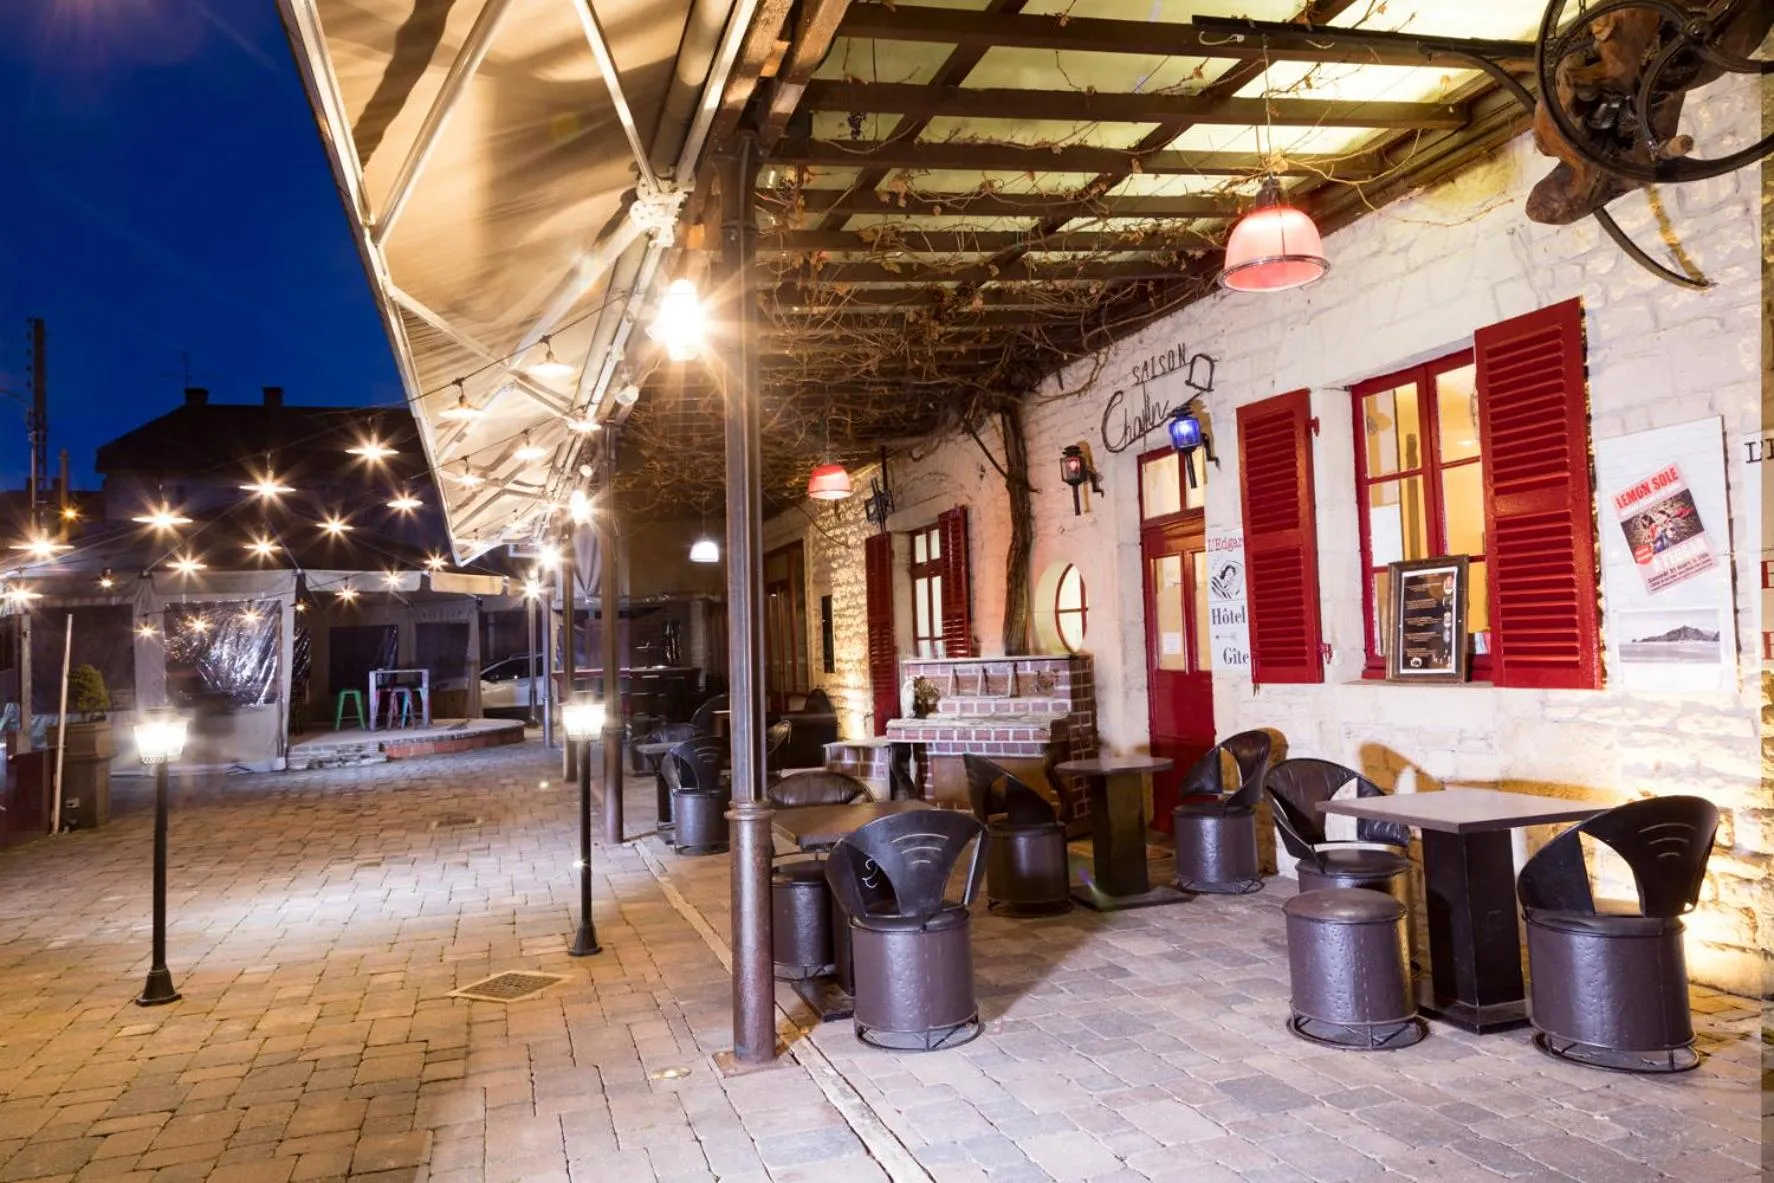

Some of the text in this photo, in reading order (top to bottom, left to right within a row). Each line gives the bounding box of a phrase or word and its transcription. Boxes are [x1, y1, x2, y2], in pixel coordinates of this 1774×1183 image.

[1132, 343, 1186, 385] SAISON
[1616, 483, 1652, 509] LEMON
[1652, 467, 1679, 491] SOLE
[1211, 605, 1246, 625] Hôtel
